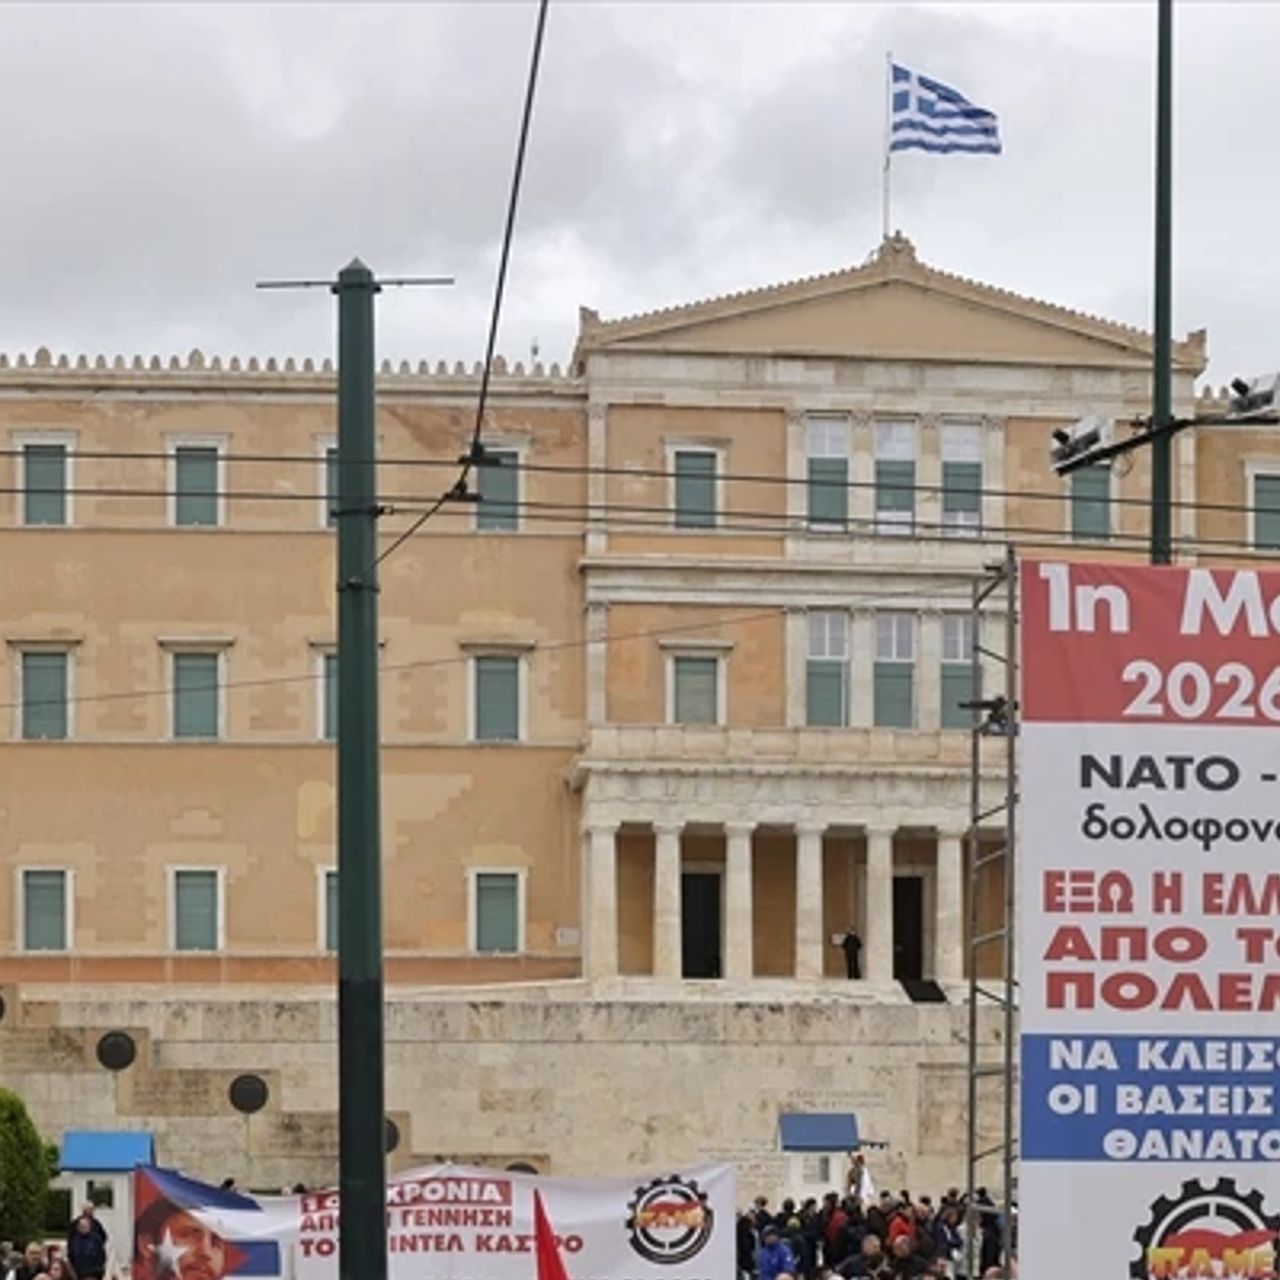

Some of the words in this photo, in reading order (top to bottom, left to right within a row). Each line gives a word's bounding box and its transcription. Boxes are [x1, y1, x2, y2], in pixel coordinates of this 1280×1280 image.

[1080, 755, 1241, 790] ΝΑΤΟ
[1043, 869, 1133, 913] ΕΞΩ
[1154, 872, 1182, 913] Η
[1043, 926, 1207, 962] ΑΠΟ
[1050, 1040, 1118, 1070] ΝΑ
[1048, 1084, 1097, 1115] ΟΙ
[1117, 1085, 1273, 1115] ΒΑΣΕΙΣ
[402, 1209, 512, 1227] ΓΕΝΝΗΣΗ
[390, 1235, 464, 1252] ΙΝΤΕΛ
